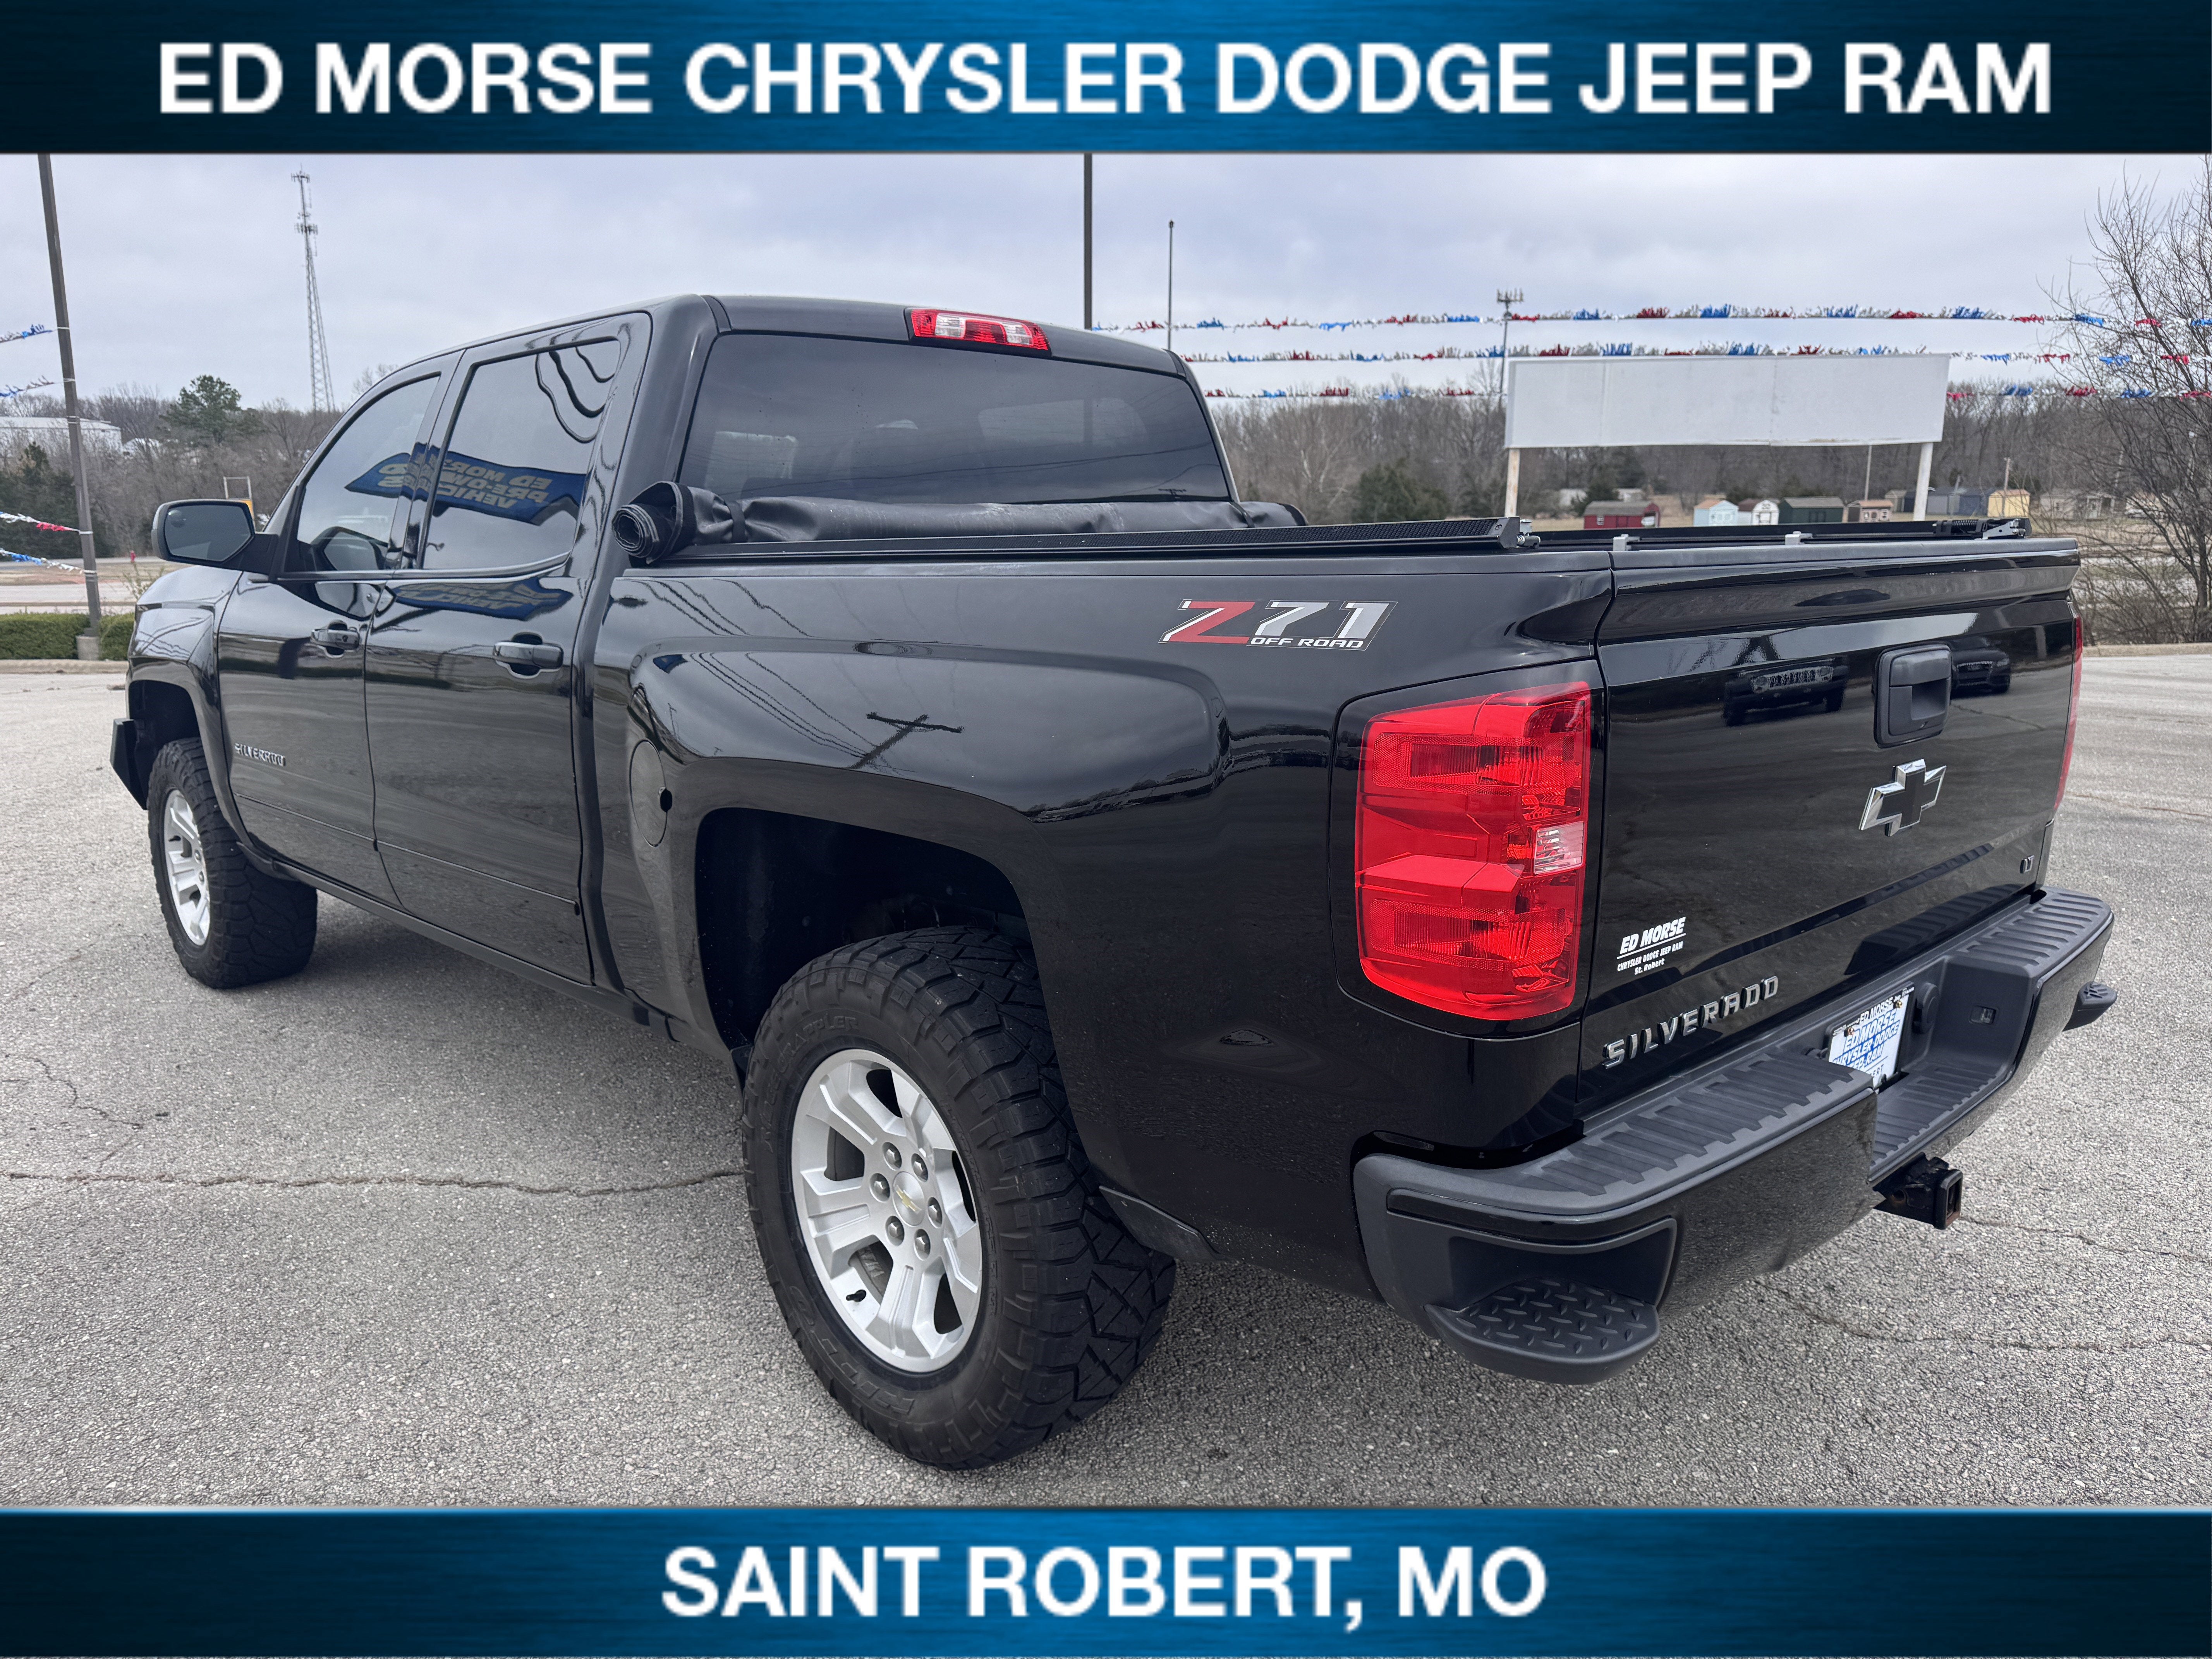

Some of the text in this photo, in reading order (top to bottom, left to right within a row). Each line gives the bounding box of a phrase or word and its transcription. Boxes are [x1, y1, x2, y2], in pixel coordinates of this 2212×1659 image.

[1159, 599, 1398, 644] Z71
[1250, 637, 1364, 649] OFF ROAD
[235, 742, 285, 766] SILVERADO
[1620, 917, 1686, 954] ED MORSE
[1617, 941, 1683, 972] CHRYSLER DODGE JEEP RAM
[1634, 958, 1665, 975] St. Robert
[1602, 975, 1778, 1070] SILVERADO
[1860, 997, 1893, 1023] ED MORSE
[1844, 1029, 1860, 1052] ED
[1859, 1009, 1897, 1044] MORSE
[1865, 1043, 1884, 1065] RAM
